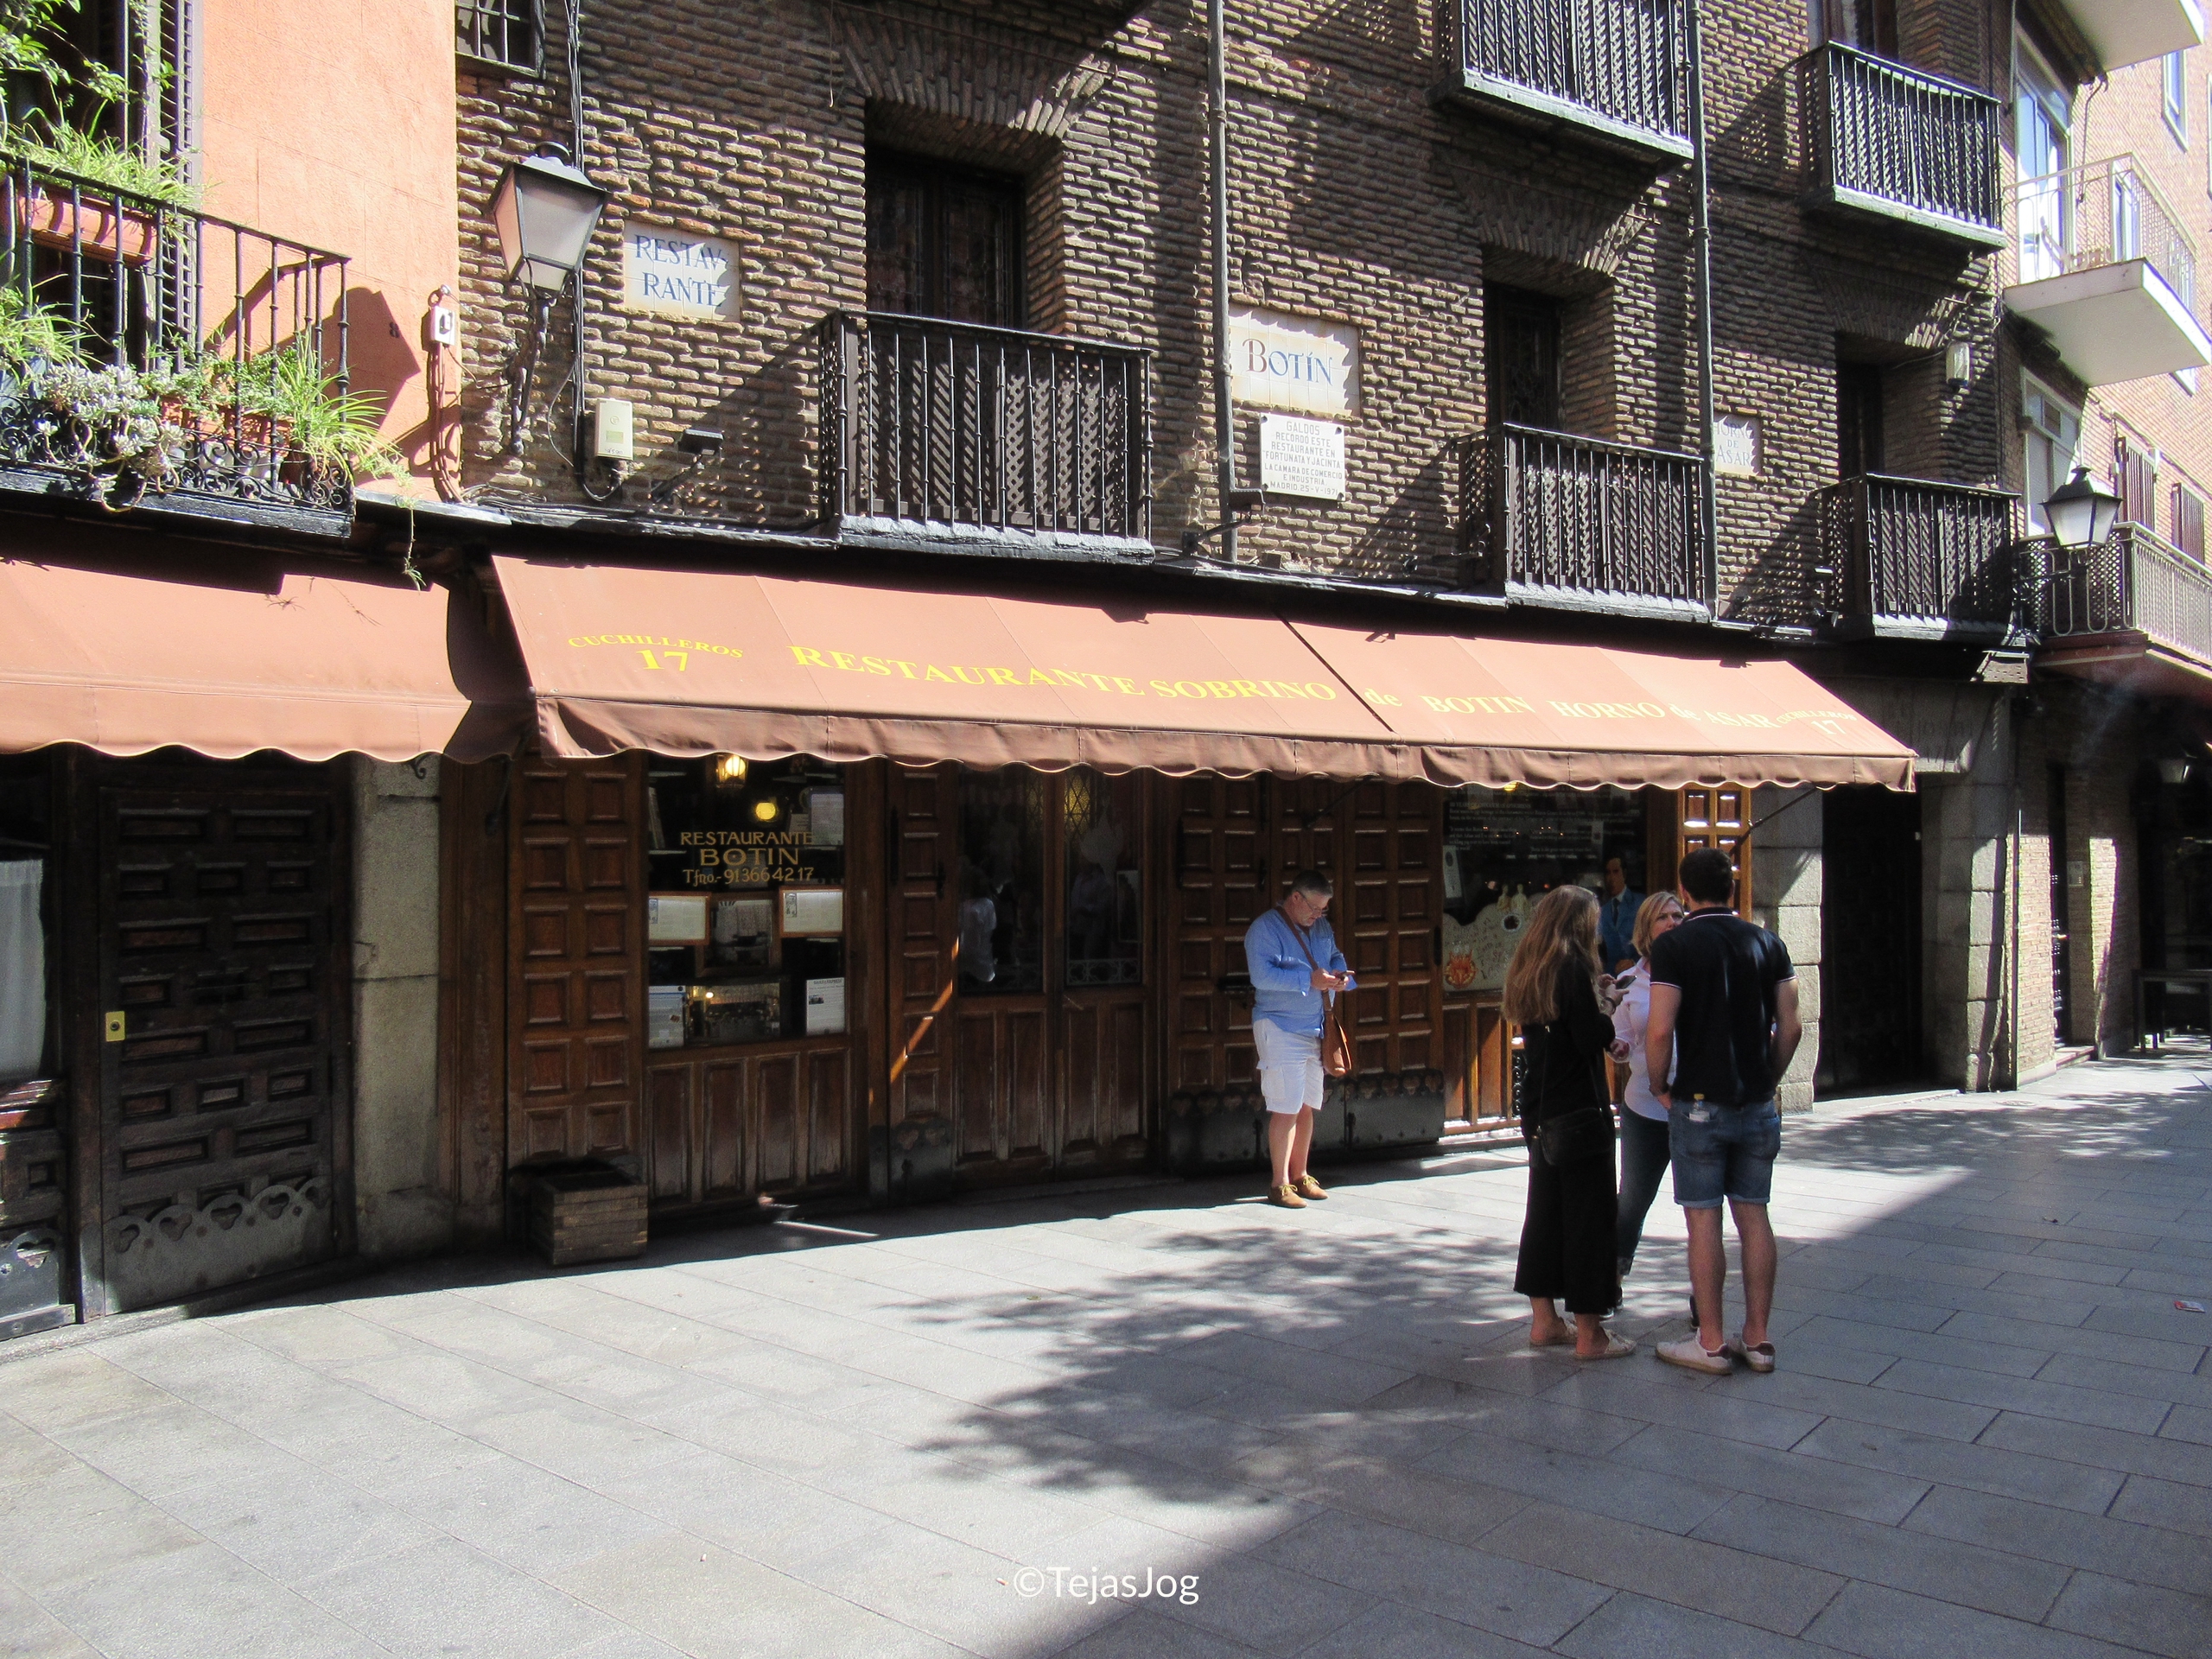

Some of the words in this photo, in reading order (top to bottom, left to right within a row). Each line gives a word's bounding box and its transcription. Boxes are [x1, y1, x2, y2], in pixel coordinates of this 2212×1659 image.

[642, 272, 722, 307] RANTE
[1243, 339, 1332, 385] BOTÍN
[1271, 442, 1324, 456] RESTAURANTE
[1325, 449, 1336, 458] EN
[1311, 437, 1331, 448] ESTE
[1306, 456, 1311, 465] Y
[1311, 468, 1343, 480] COMERCIO
[568, 634, 743, 658] CUCHILLEROS
[636, 649, 688, 671] 17
[786, 645, 1146, 696] RESTAURANTE
[1149, 680, 1338, 701] SOBRINO
[1364, 687, 1402, 707] de
[1419, 695, 1535, 715] BOTIN
[1546, 699, 1667, 720] HORNO
[1669, 702, 1701, 721] de
[1703, 709, 1783, 728] ASAR
[1776, 710, 1859, 724] CUCHILLEROS
[1810, 720, 1847, 735] 17
[680, 830, 814, 846] RESTAURANTE
[700, 848, 799, 866] BOTIN
